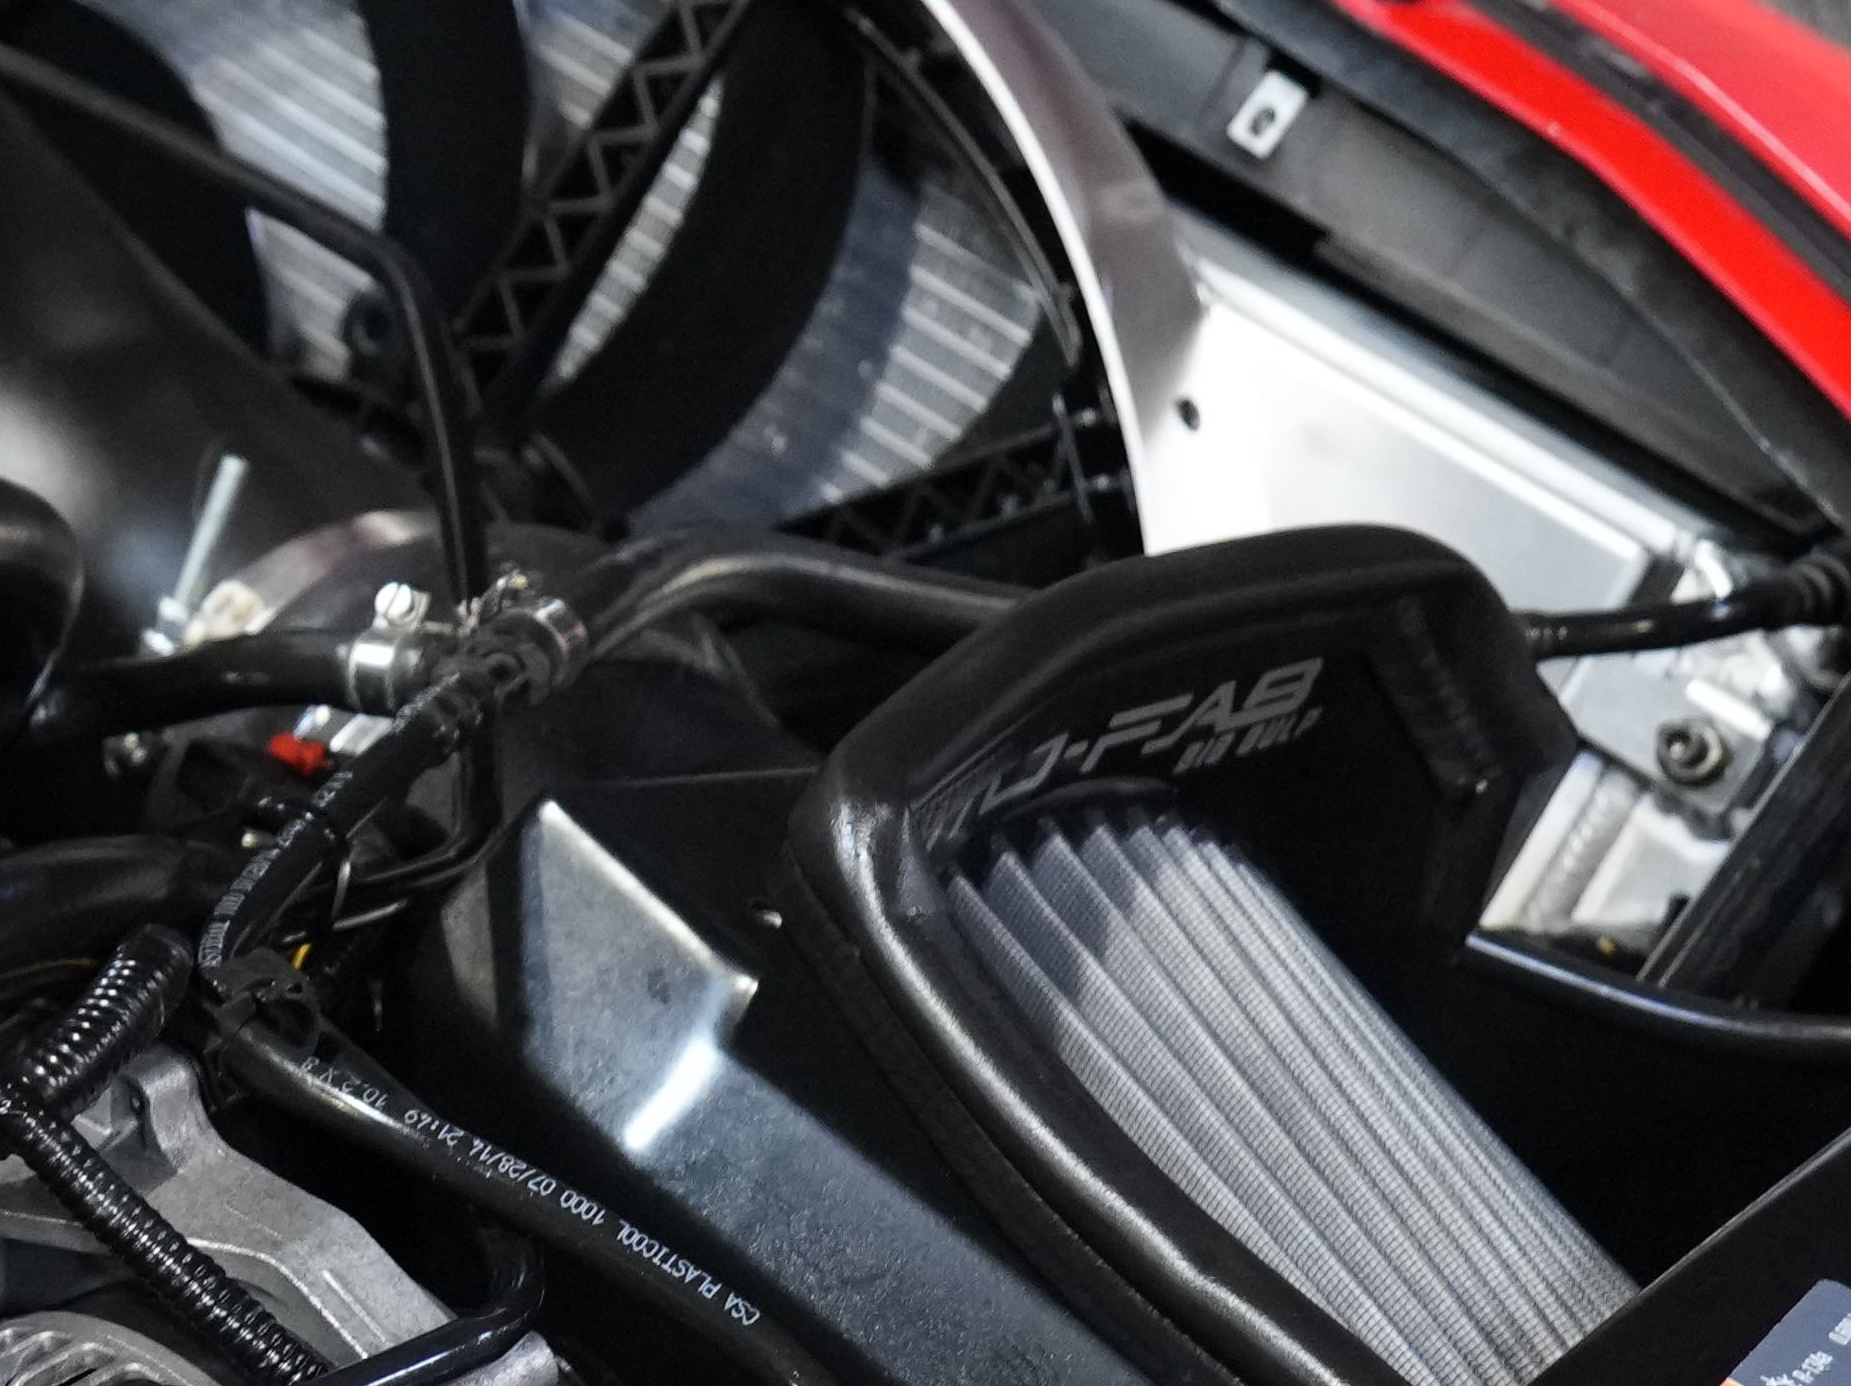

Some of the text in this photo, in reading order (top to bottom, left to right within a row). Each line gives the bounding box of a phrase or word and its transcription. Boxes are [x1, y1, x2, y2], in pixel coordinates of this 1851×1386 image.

[402, 1108, 466, 1148] 21:49
[469, 1137, 558, 1198] 07/28/14
[559, 1189, 606, 1227] 1000
[618, 1218, 724, 1301] PLASTICOOL
[724, 1289, 761, 1326] CSA
